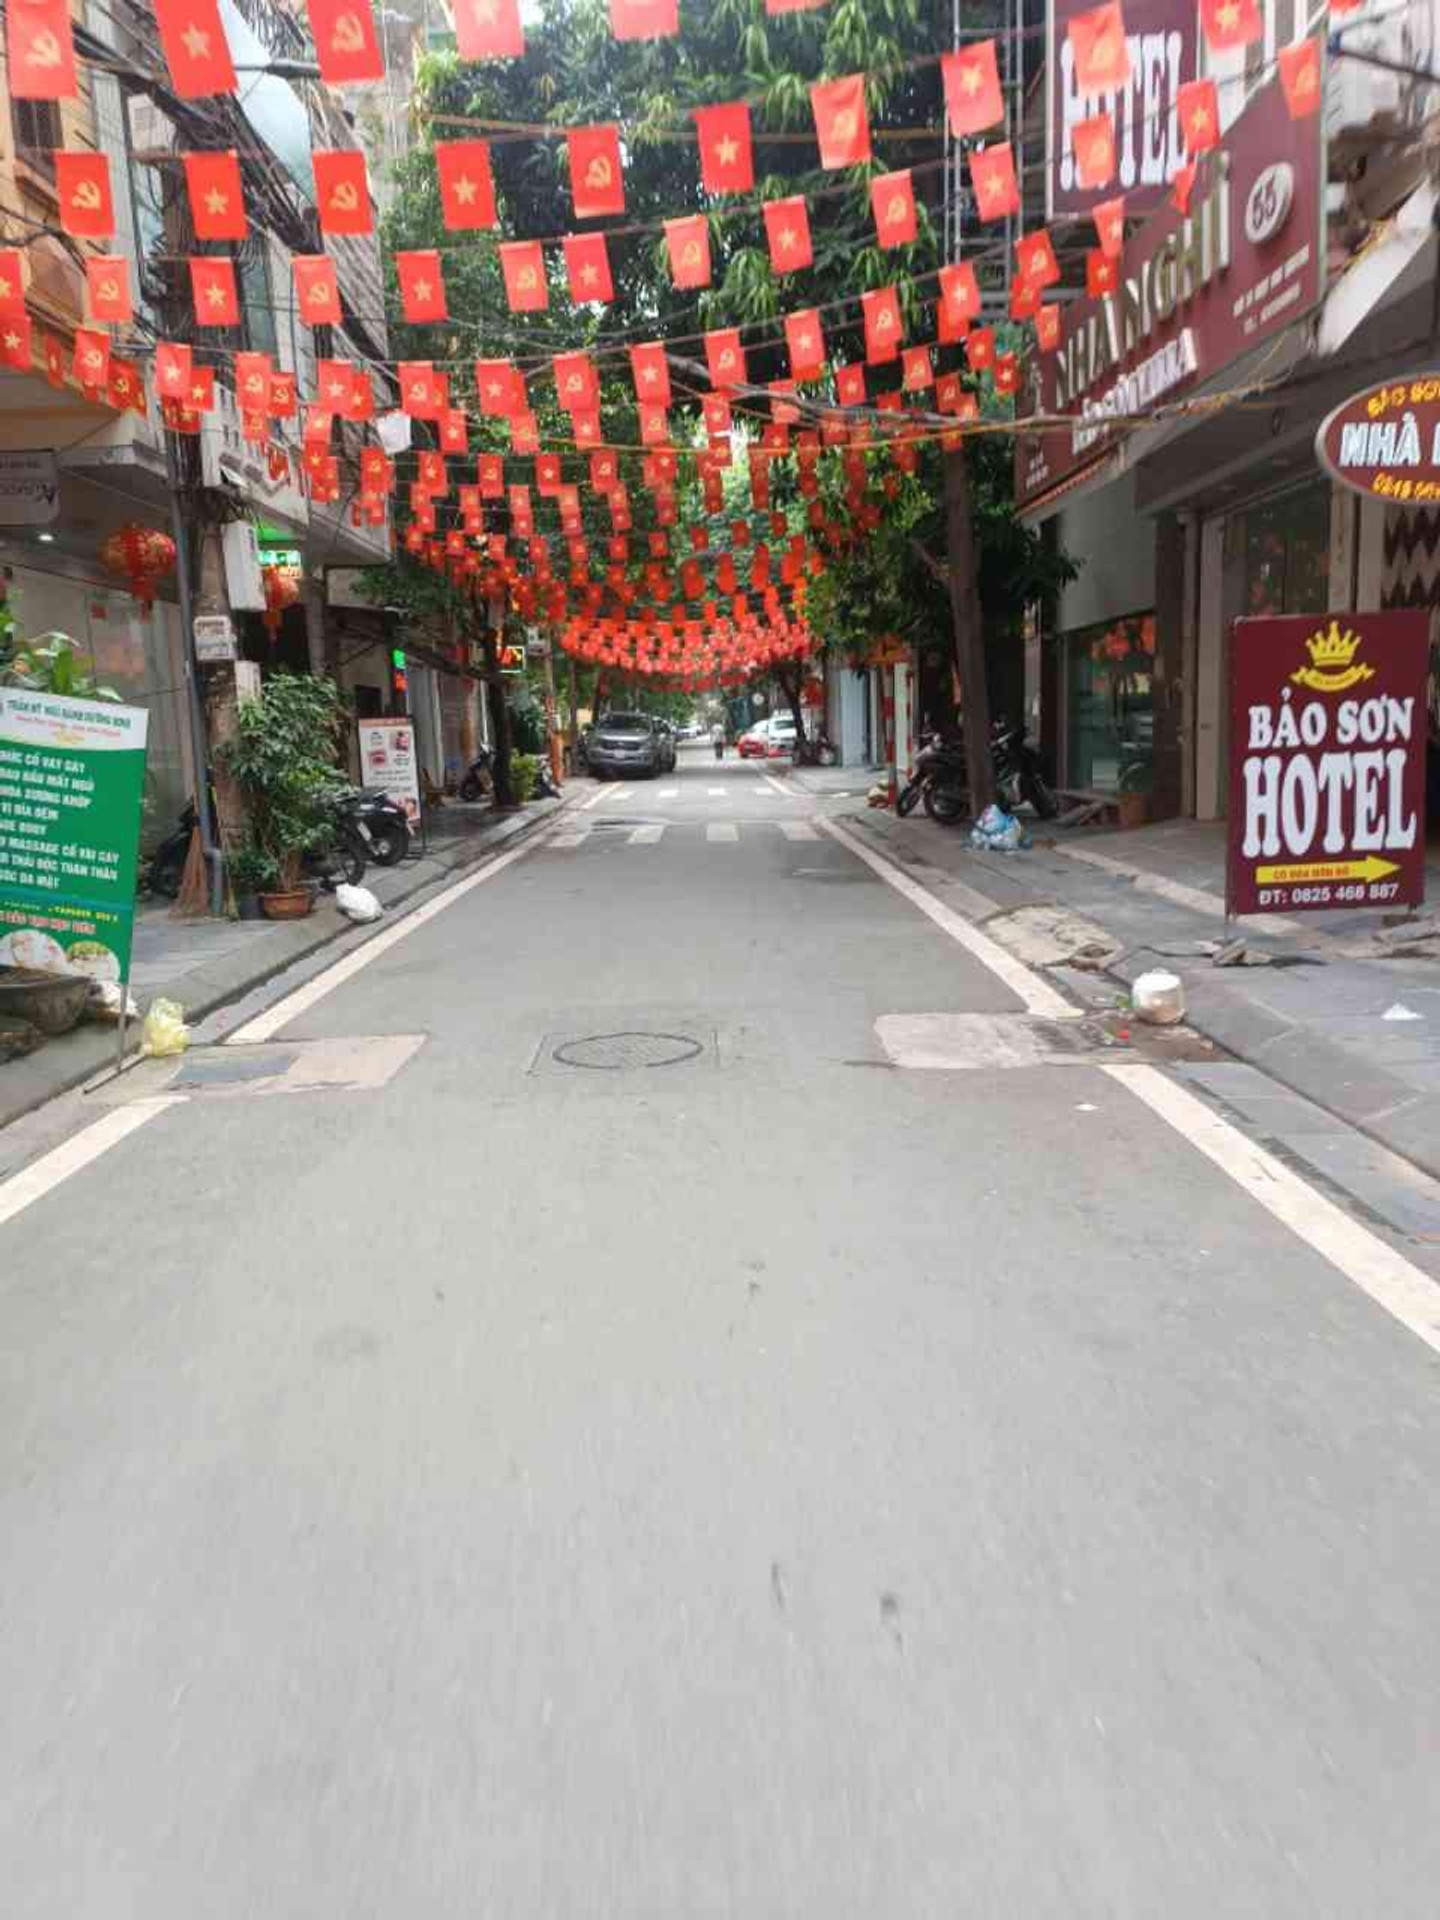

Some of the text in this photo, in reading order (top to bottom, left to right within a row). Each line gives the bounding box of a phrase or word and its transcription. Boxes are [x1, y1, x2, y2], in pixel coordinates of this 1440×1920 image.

[1060, 28, 1192, 192] HTEL
[1248, 686, 1415, 749] BẢO SƠN
[1242, 748, 1417, 859] HOTEL
[1259, 889, 1288, 905] ĐT:
